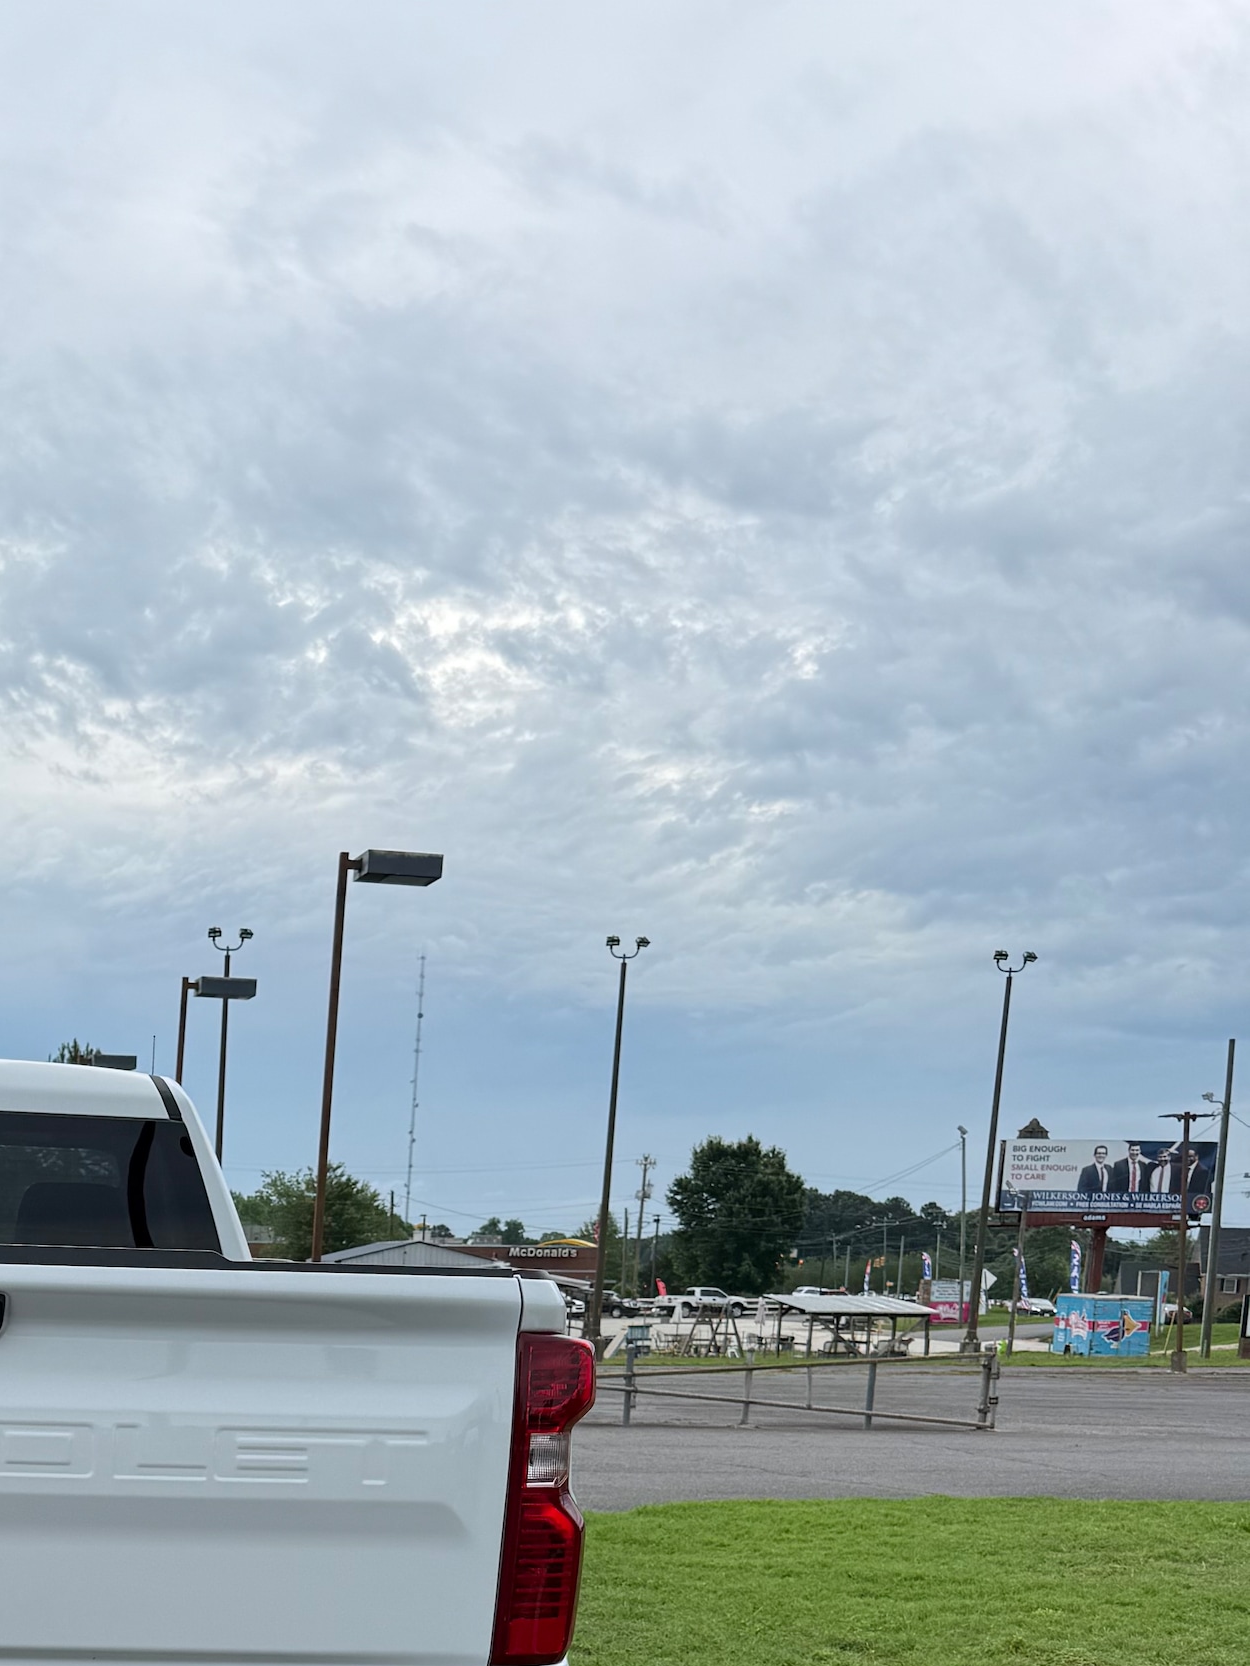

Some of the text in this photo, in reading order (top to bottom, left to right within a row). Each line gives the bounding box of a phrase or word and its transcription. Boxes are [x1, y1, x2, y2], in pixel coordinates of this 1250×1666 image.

[1012, 1145, 1067, 1153] BIG ENOUGH
[1012, 1154, 1024, 1162] TO
[1011, 1164, 1078, 1172] SMALL ENOUGH
[1011, 1173, 1046, 1181] TO CARE
[1033, 1191, 1090, 1201] WILKERSON,
[1091, 1192, 1121, 1202] JONES
[1122, 1193, 1130, 1201] &
[509, 1247, 577, 1258] McDonald's
